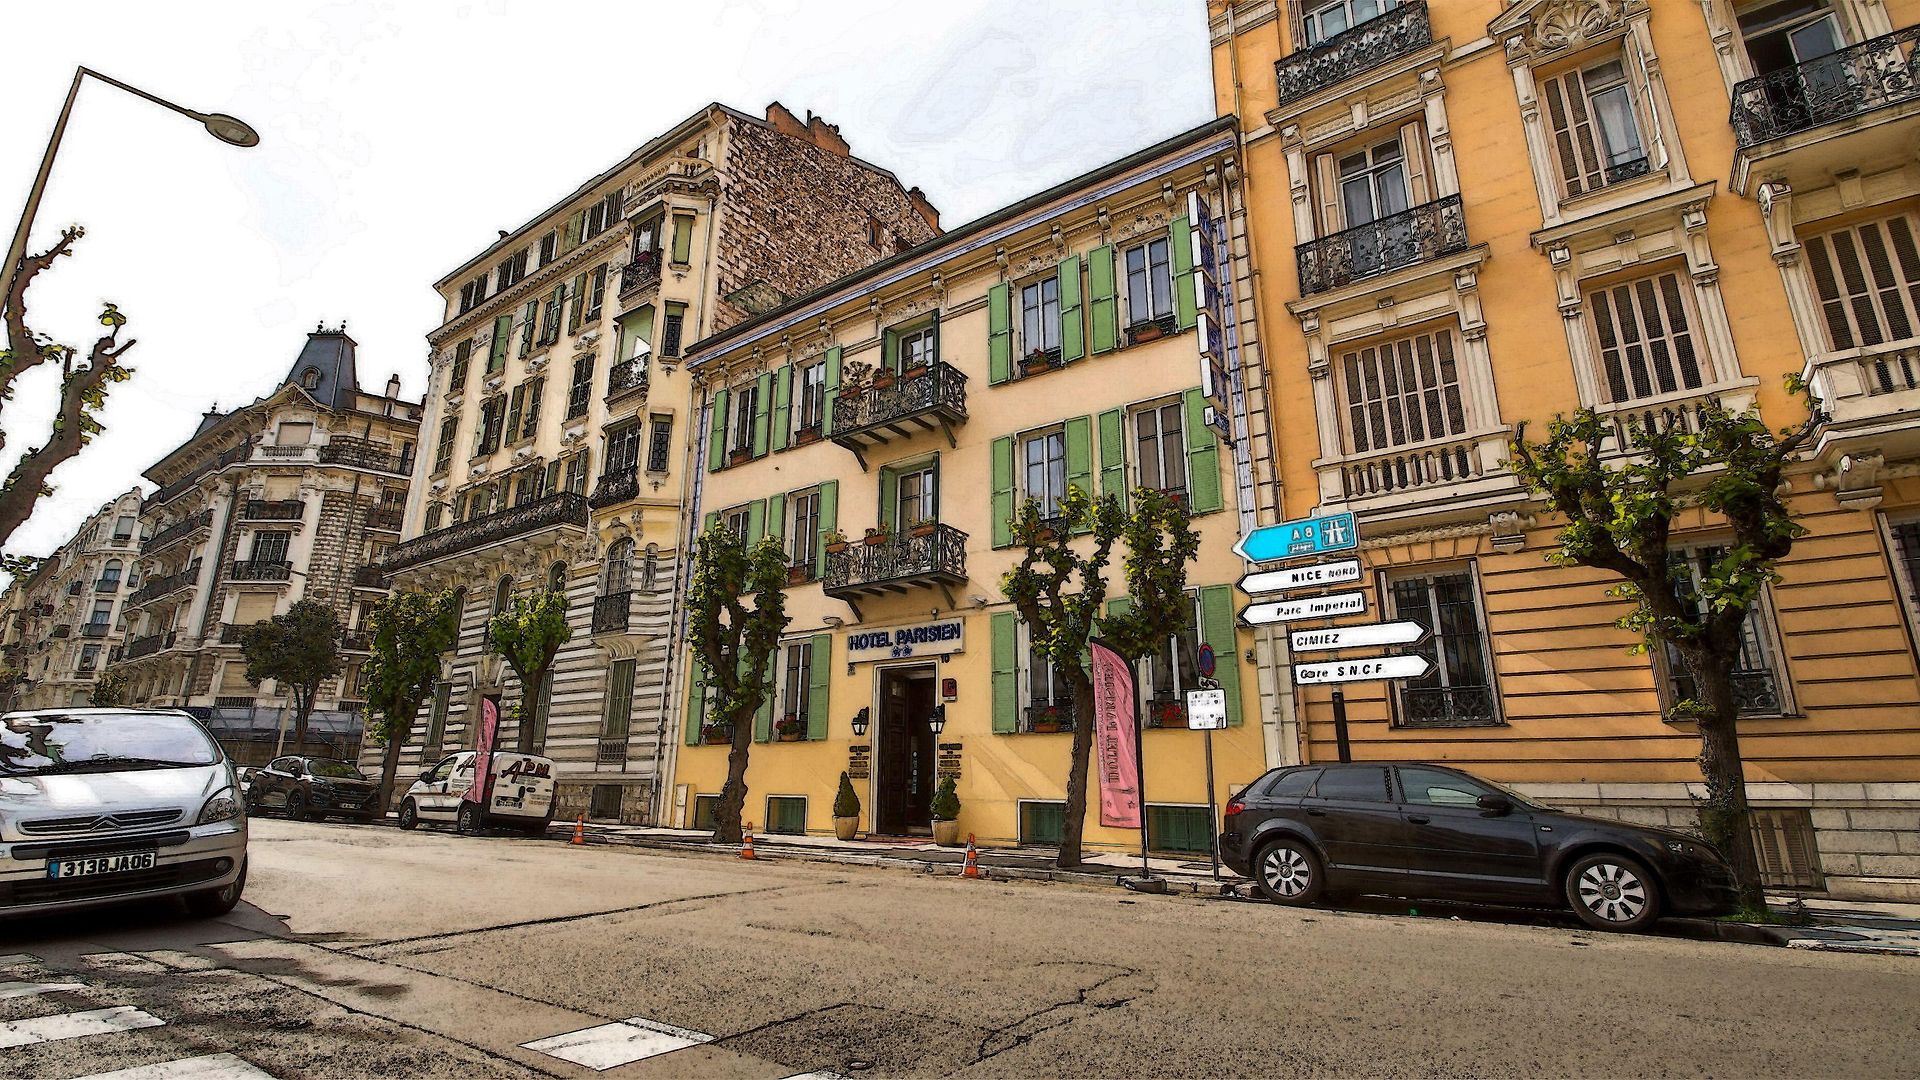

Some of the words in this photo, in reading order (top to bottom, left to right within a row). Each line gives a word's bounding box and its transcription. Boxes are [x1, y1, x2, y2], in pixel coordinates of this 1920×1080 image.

[1292, 529, 1301, 541] A
[1304, 526, 1314, 539] 8
[1291, 570, 1322, 583] NICE
[1328, 566, 1356, 578] NORD
[1276, 606, 1302, 617] Parc
[1310, 597, 1361, 613] Imperial
[848, 631, 893, 651] HOTEL
[894, 622, 961, 646] PARISIEN
[1296, 633, 1340, 647] CIMIEZ
[1300, 669, 1329, 680] Gare
